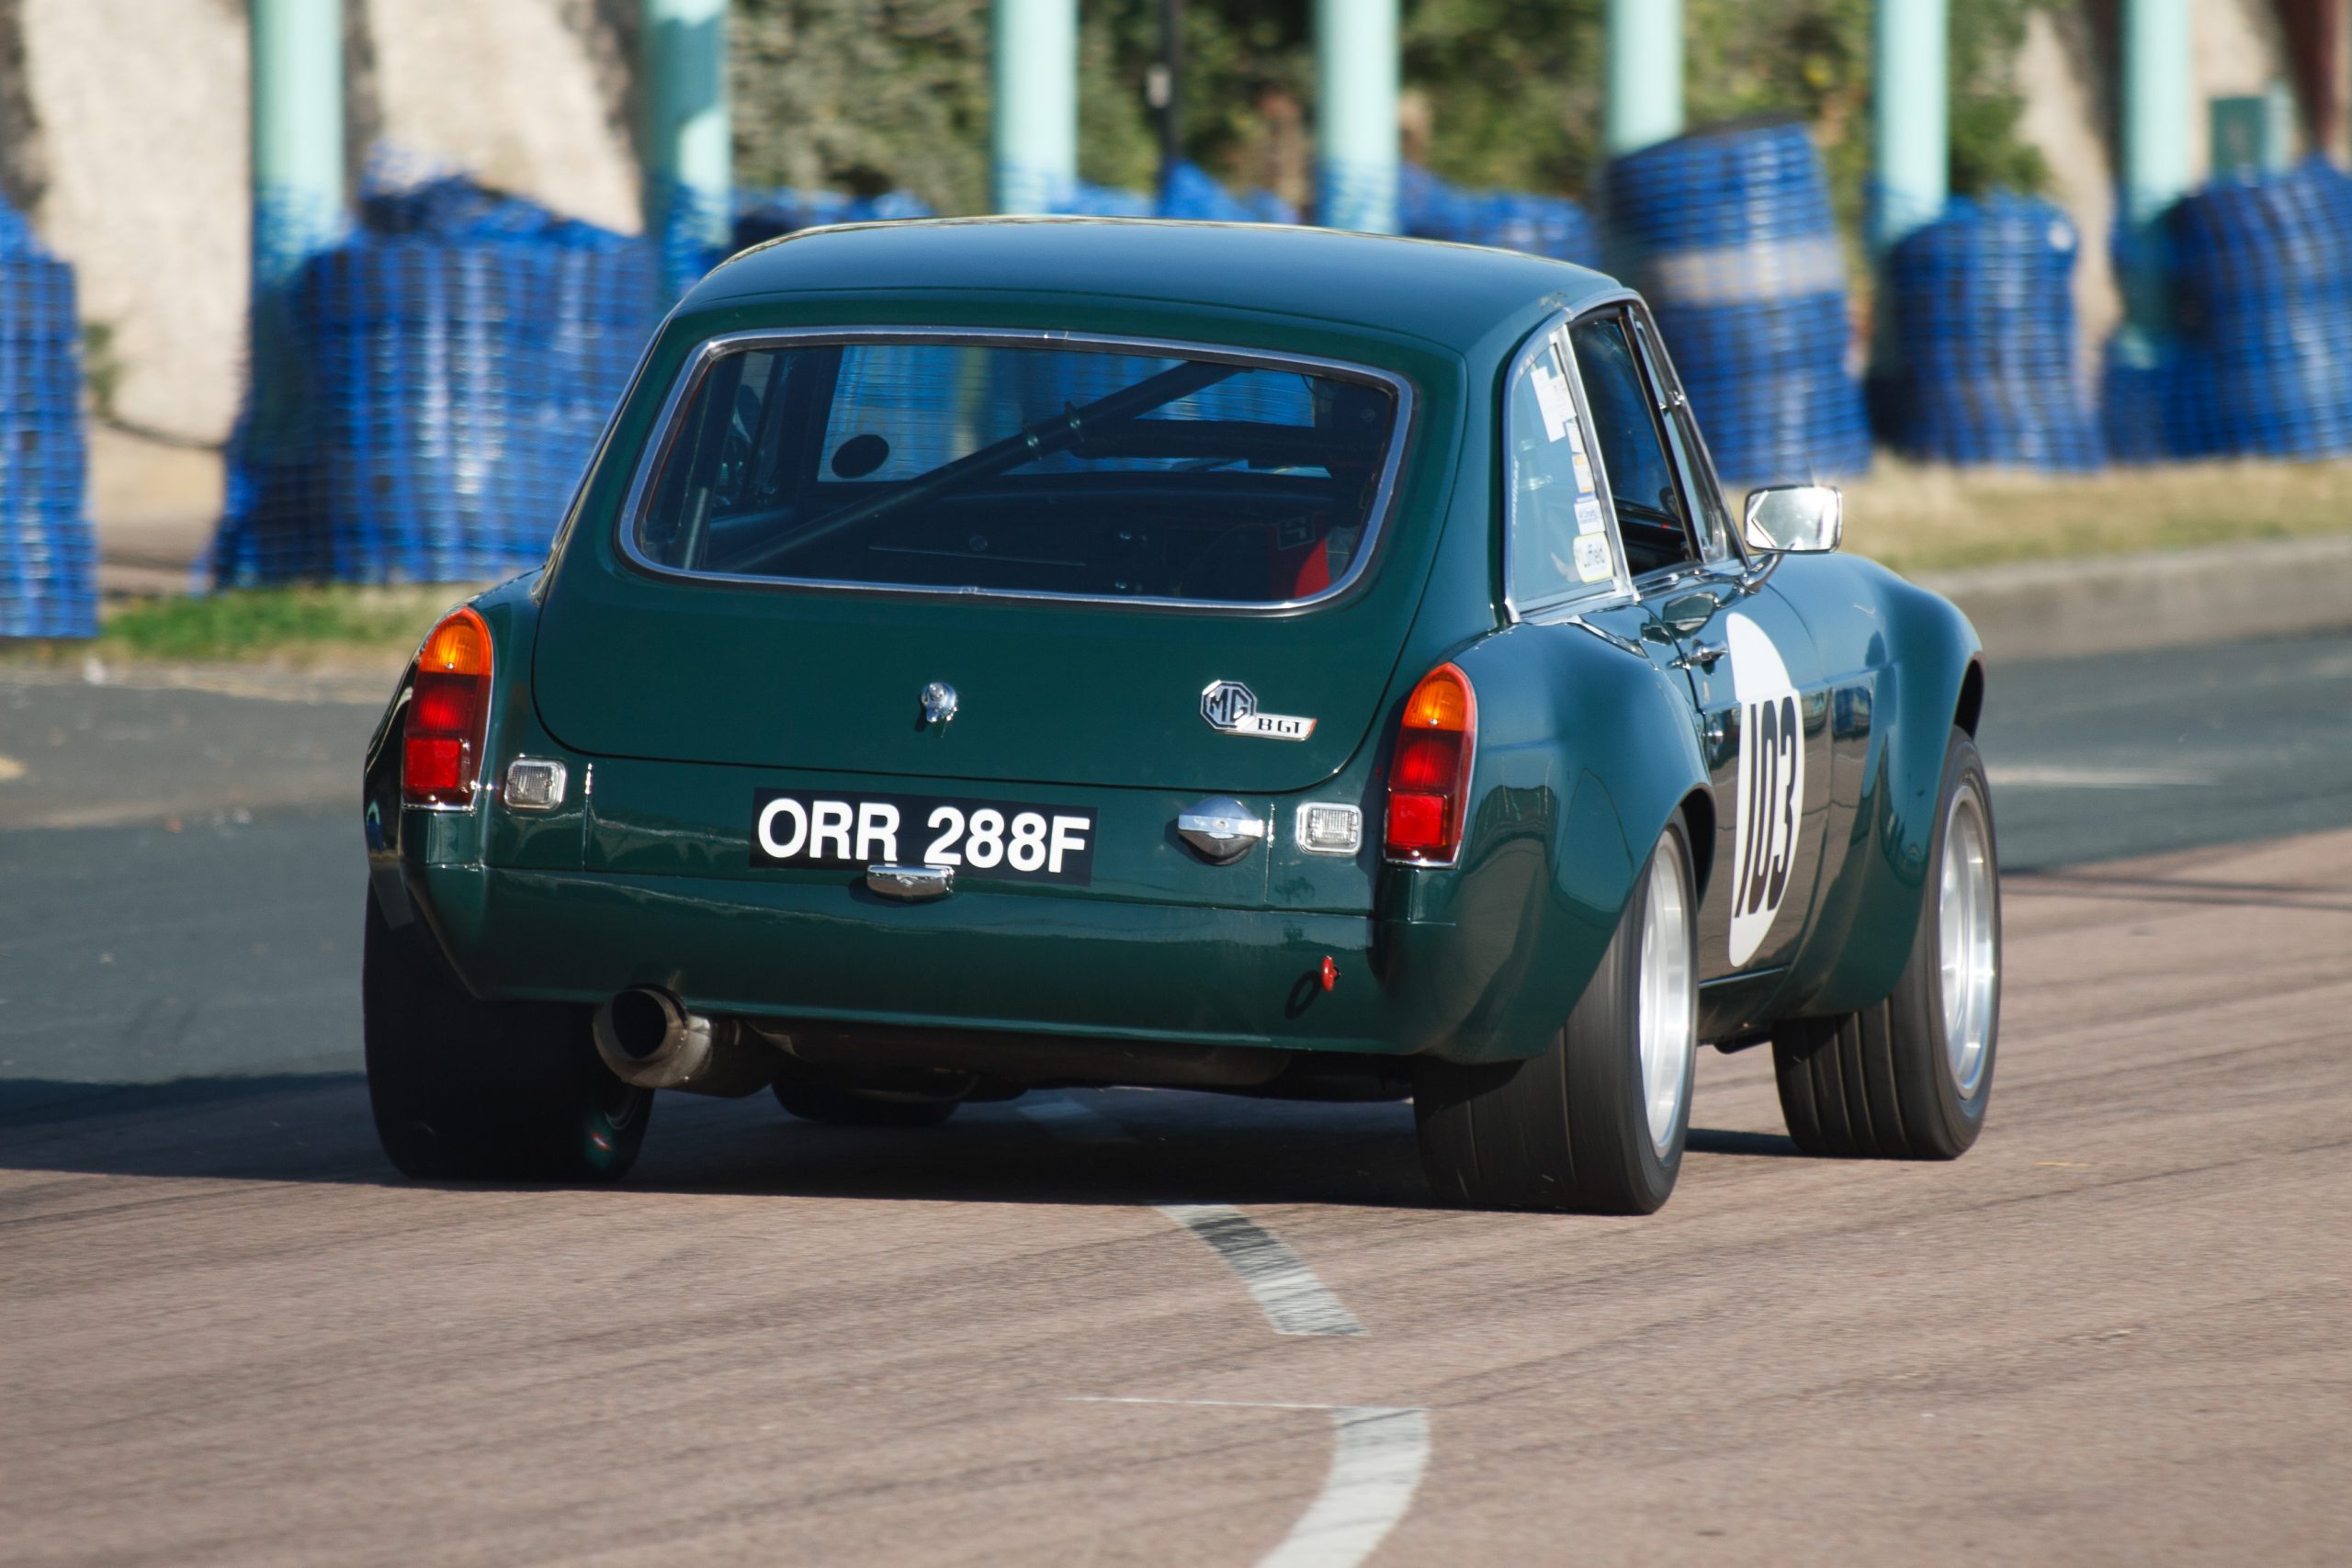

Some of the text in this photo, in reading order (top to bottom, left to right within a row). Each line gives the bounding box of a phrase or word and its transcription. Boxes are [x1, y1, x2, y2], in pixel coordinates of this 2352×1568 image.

[1209, 688, 1250, 723] MG
[758, 797, 1091, 874] ORR 288F
[1735, 695, 1797, 919] 103
